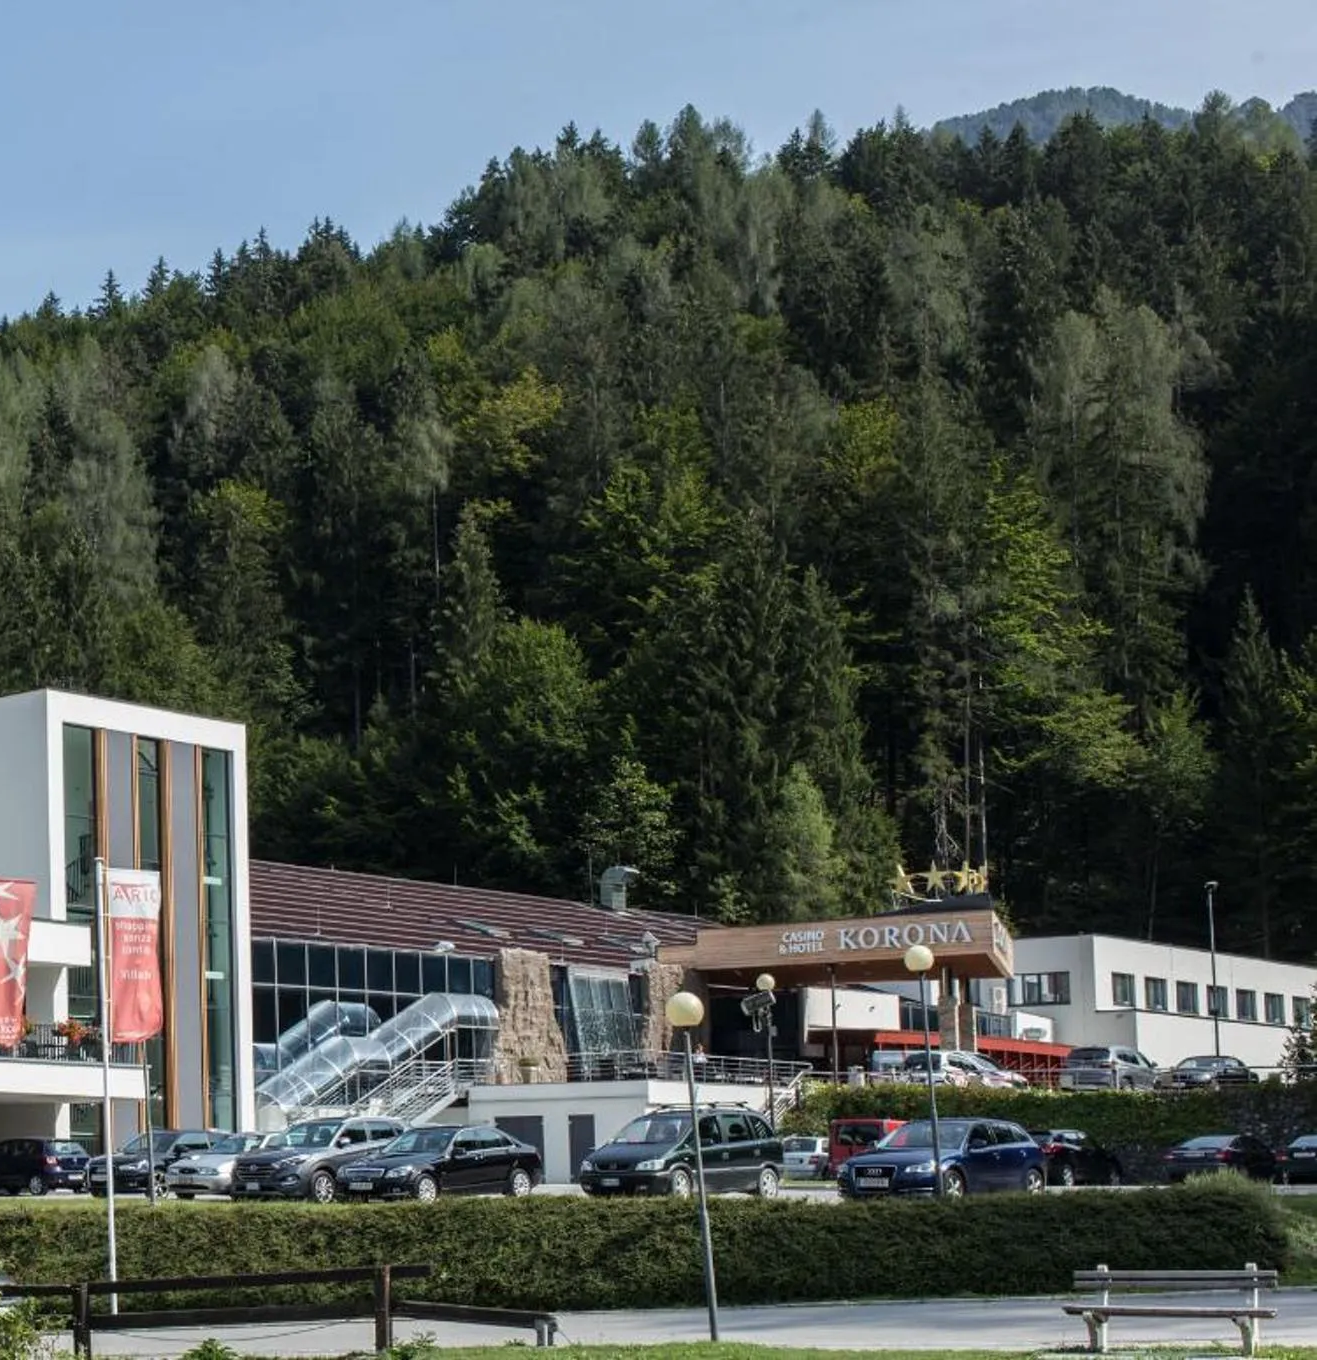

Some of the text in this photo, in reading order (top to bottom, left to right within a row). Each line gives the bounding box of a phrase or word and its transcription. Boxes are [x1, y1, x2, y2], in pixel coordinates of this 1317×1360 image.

[781, 928, 824, 943] CASINO
[838, 920, 973, 951] KORONA
[789, 941, 825, 954] HOTEL
